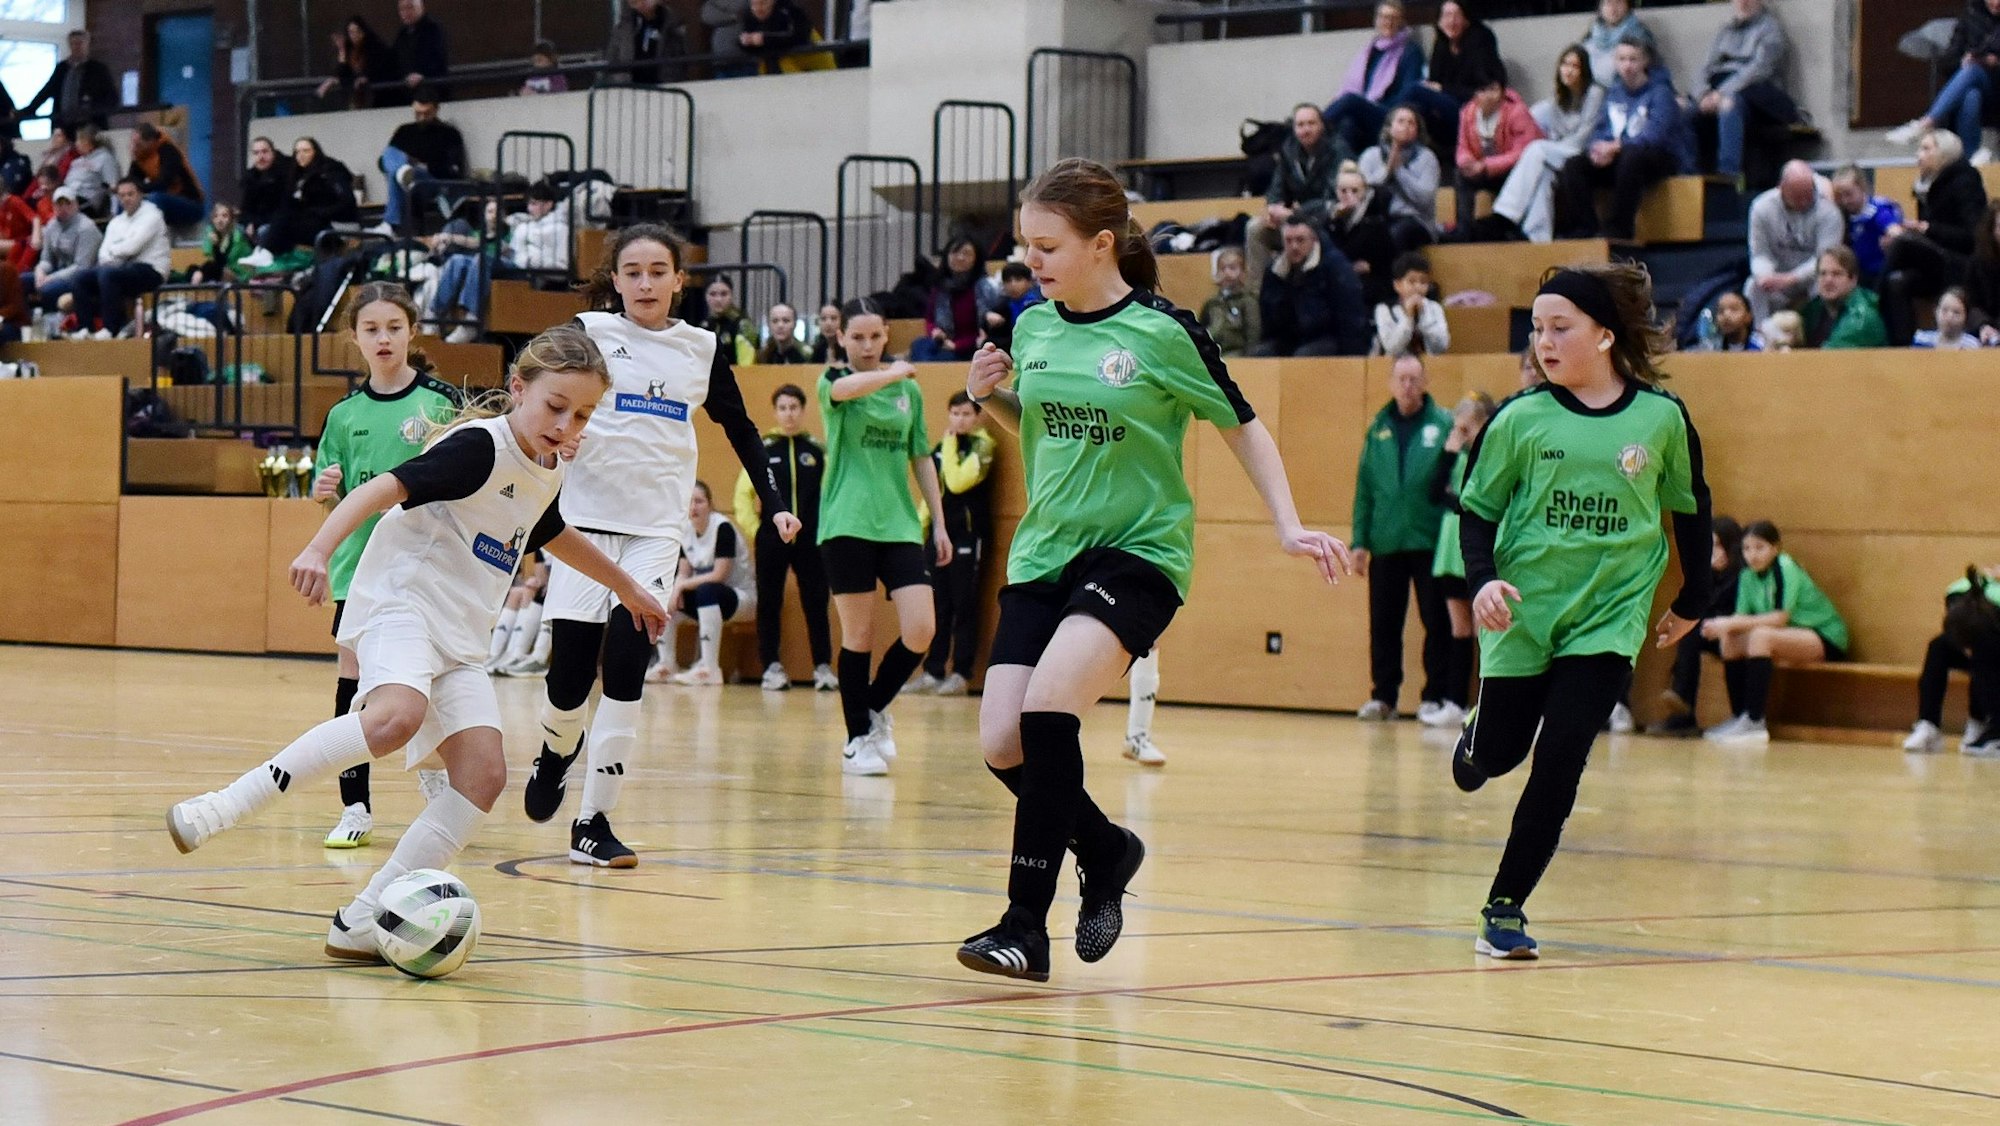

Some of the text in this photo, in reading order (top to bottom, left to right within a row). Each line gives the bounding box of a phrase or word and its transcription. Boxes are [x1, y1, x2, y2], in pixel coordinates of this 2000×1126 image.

[1024, 360, 1048, 371] JAKO
[620, 398, 684, 416] PAEDIPROTECT
[1041, 402, 1109, 423] Rhein
[1043, 417, 1126, 446] Energie
[1553, 489, 1618, 513] Rhein
[1546, 506, 1628, 537] Energie
[1095, 586, 1116, 606] JAKO
[1012, 855, 1047, 870] JAKO
